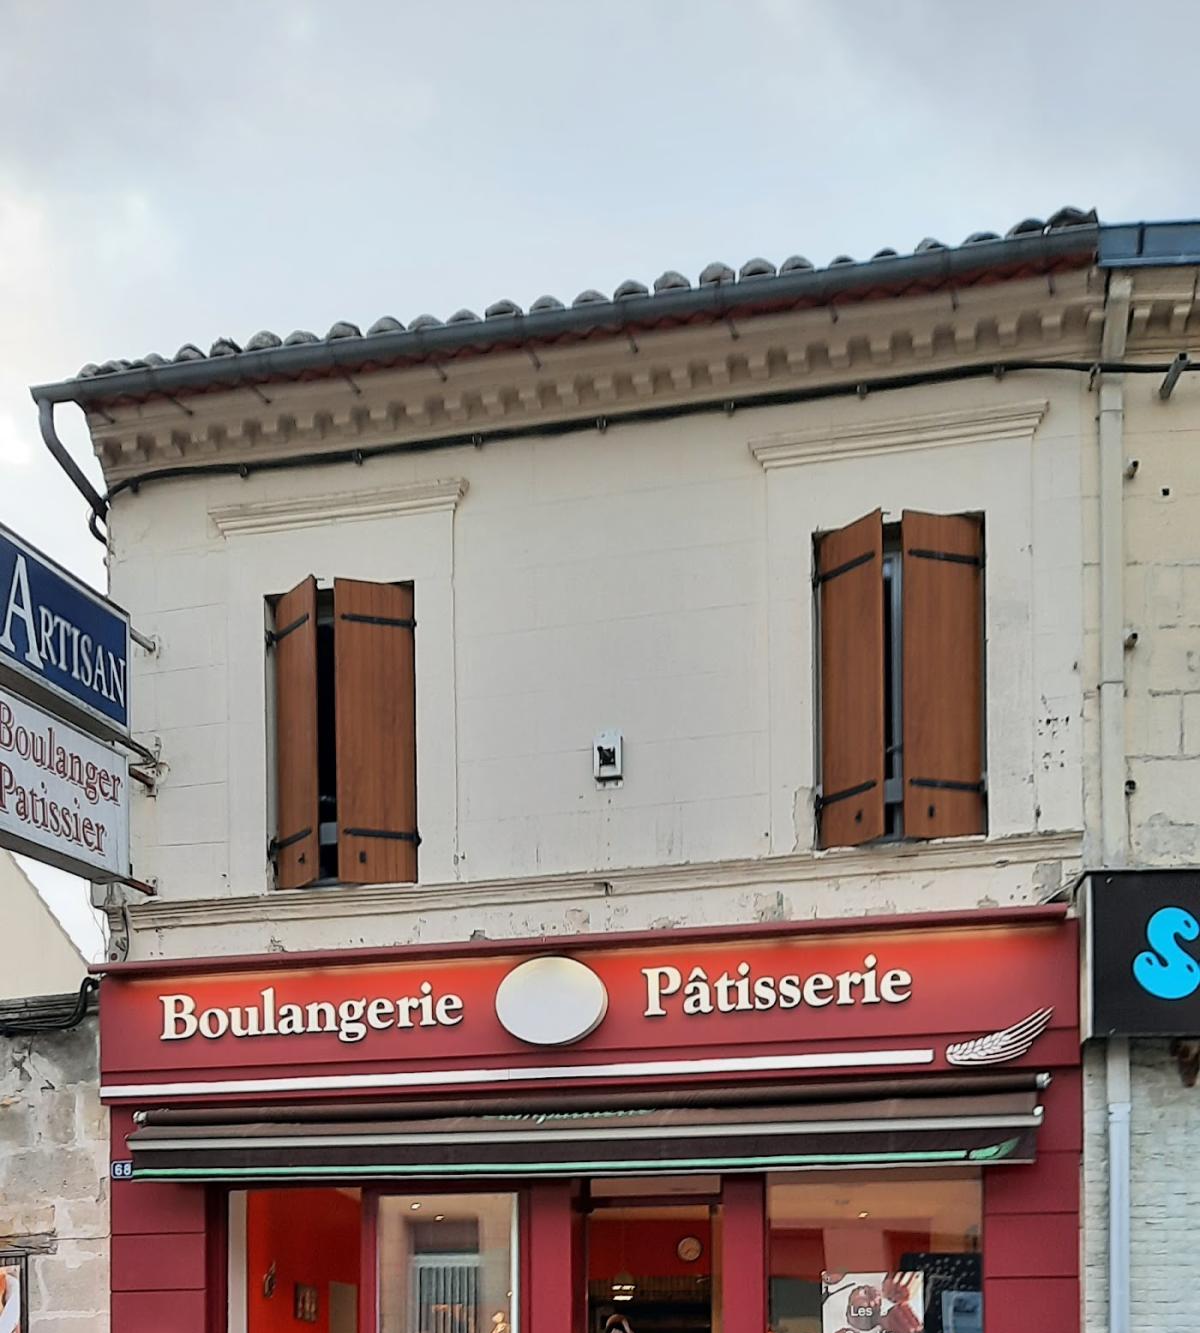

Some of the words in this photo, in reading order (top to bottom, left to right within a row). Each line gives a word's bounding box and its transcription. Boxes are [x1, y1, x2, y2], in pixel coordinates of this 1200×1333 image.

[0, 554, 126, 708] ARTISAN
[0, 701, 122, 806] Boulanger
[0, 762, 107, 856] Patissier
[159, 982, 464, 1042] Boulangerie
[642, 954, 912, 1017] Pâtisserie
[1133, 907, 1200, 999] S
[114, 1163, 132, 1176] 68
[851, 1306, 873, 1317] Les
